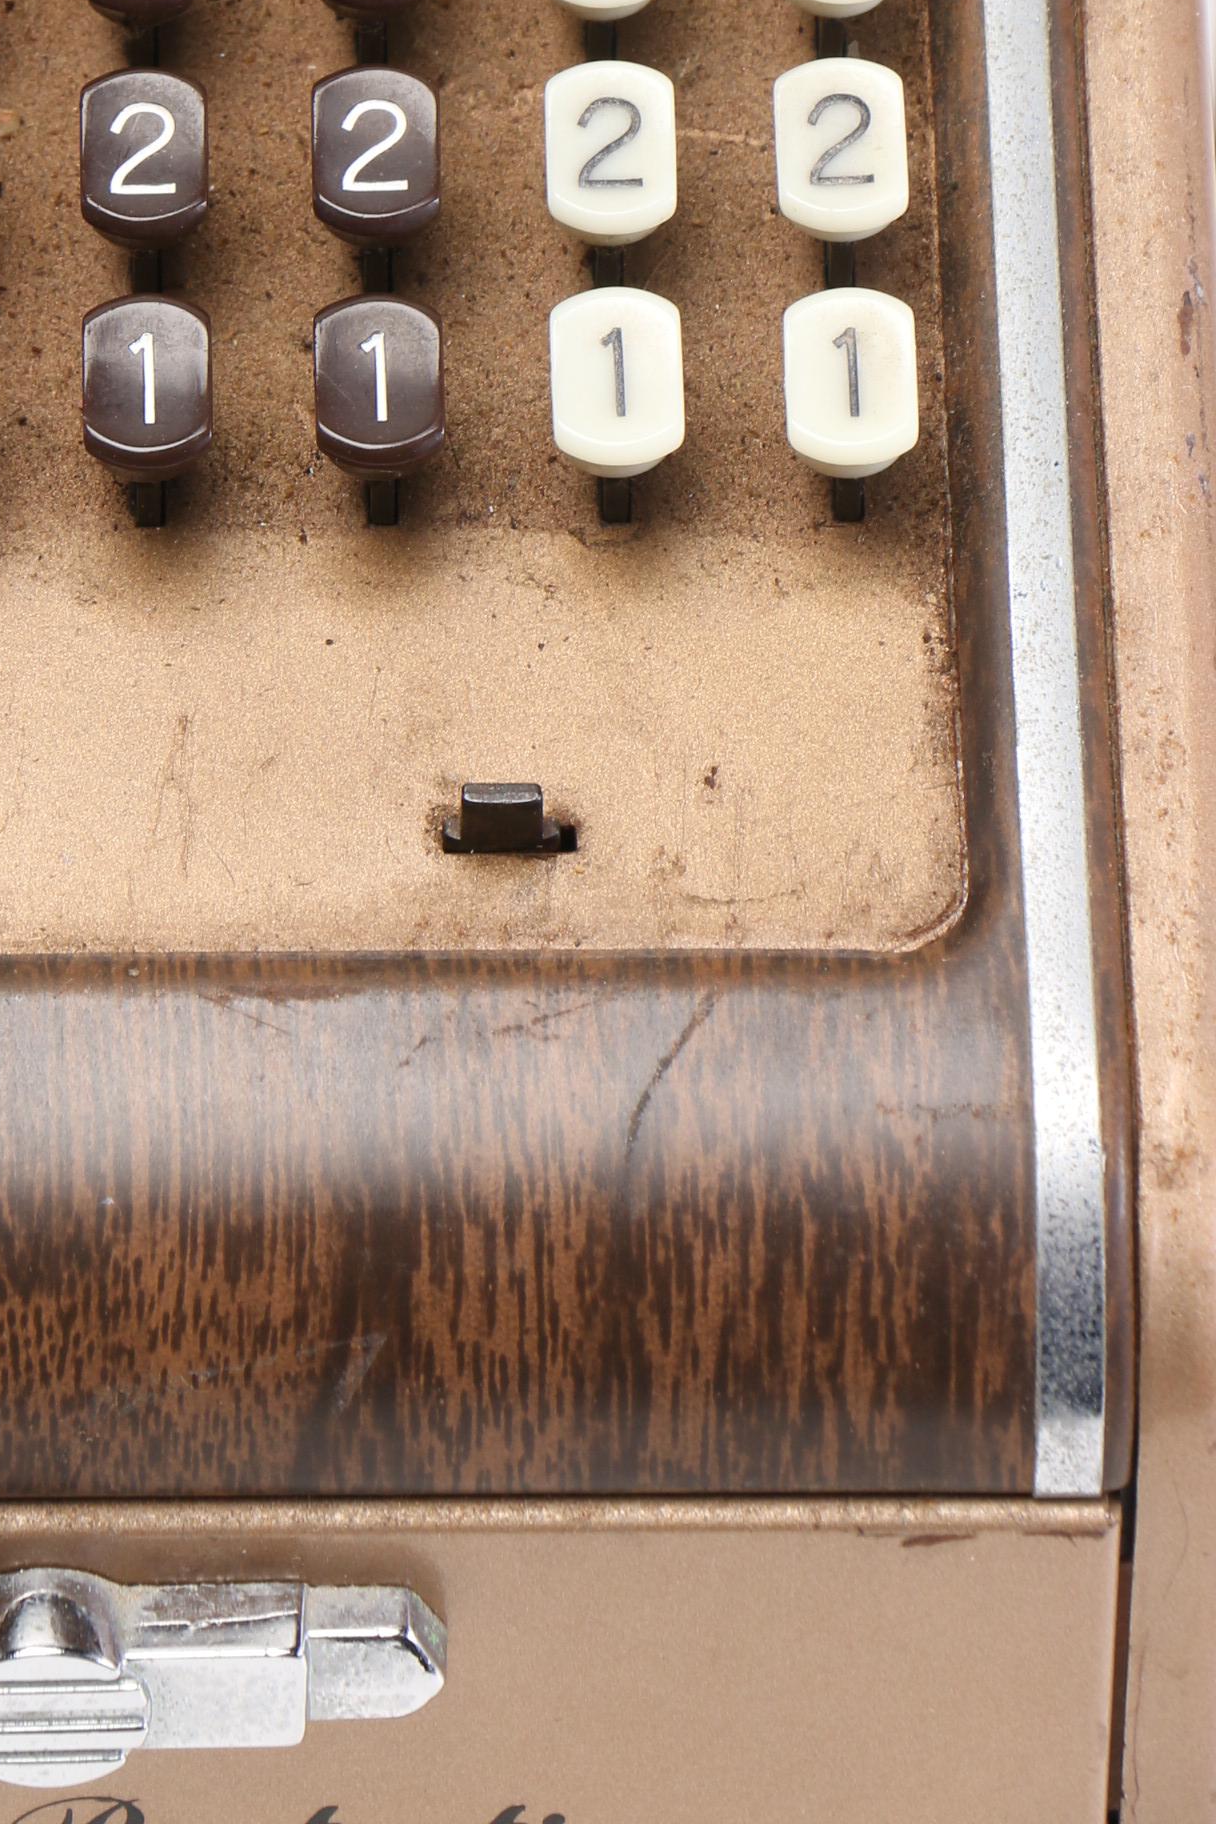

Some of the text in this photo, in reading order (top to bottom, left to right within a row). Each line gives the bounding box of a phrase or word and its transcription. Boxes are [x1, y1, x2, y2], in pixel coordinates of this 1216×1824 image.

[110, 103, 176, 195] 2
[342, 100, 408, 192] 2
[577, 96, 644, 189] 2
[807, 93, 875, 186] 2
[129, 333, 156, 424] 1
[361, 332, 388, 422] 1
[600, 327, 627, 417] 1
[832, 327, 861, 418] 1
